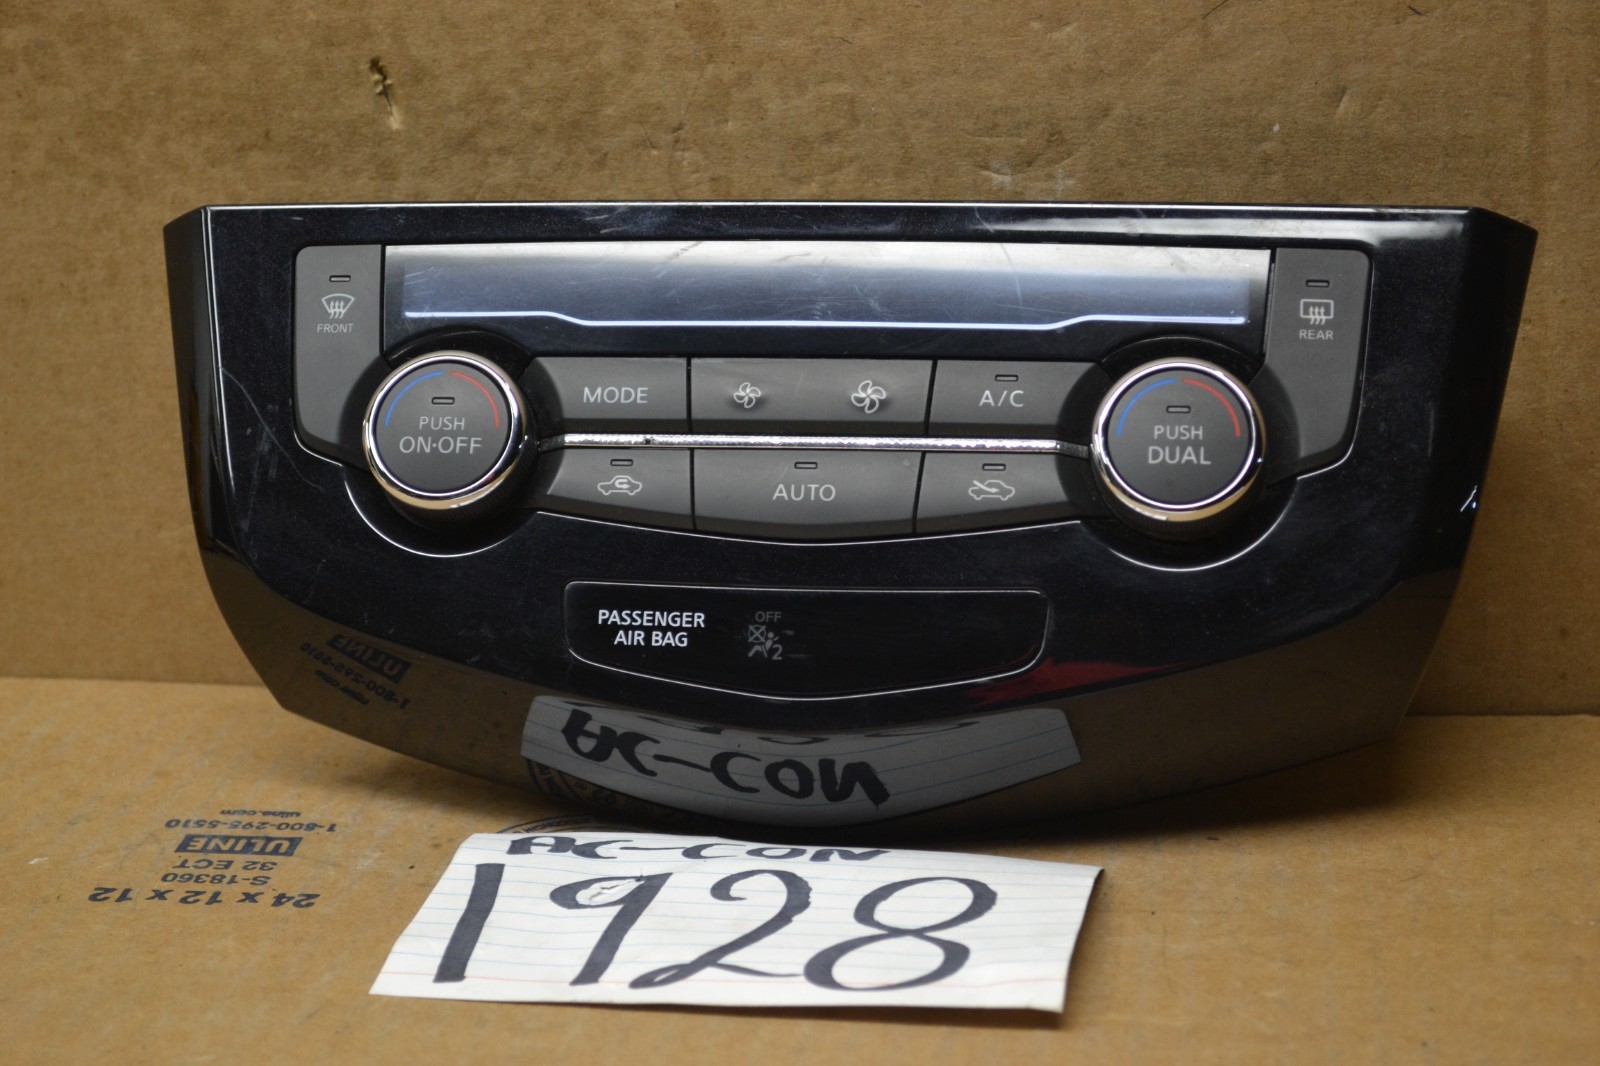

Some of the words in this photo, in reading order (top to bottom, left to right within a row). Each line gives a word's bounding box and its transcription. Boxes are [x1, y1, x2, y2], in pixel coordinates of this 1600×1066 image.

[316, 323, 354, 334] FRONT
[1298, 328, 1335, 341] REAR
[583, 386, 649, 404] MODE
[978, 389, 1025, 409] A/C
[418, 416, 466, 431] PUSH
[1153, 424, 1205, 442] PUSH
[1147, 445, 1212, 467] DUAL
[772, 483, 837, 503] AUTO
[597, 609, 706, 628] PASSENGER
[754, 611, 782, 623] OFF
[613, 630, 645, 646] AIR
[651, 631, 688, 647] BAG
[164, 818, 337, 833] 1-800-295-5510
[183, 836, 293, 854] ULINE
[172, 858, 235, 870] ECT
[242, 860, 278, 871] 32
[161, 872, 272, 886] S-18360
[87, 886, 133, 903] 12
[145, 888, 174, 901] x
[179, 890, 223, 906] 12
[236, 891, 265, 904] x
[271, 892, 321, 909] 24
[432, 863, 999, 992] 1928
